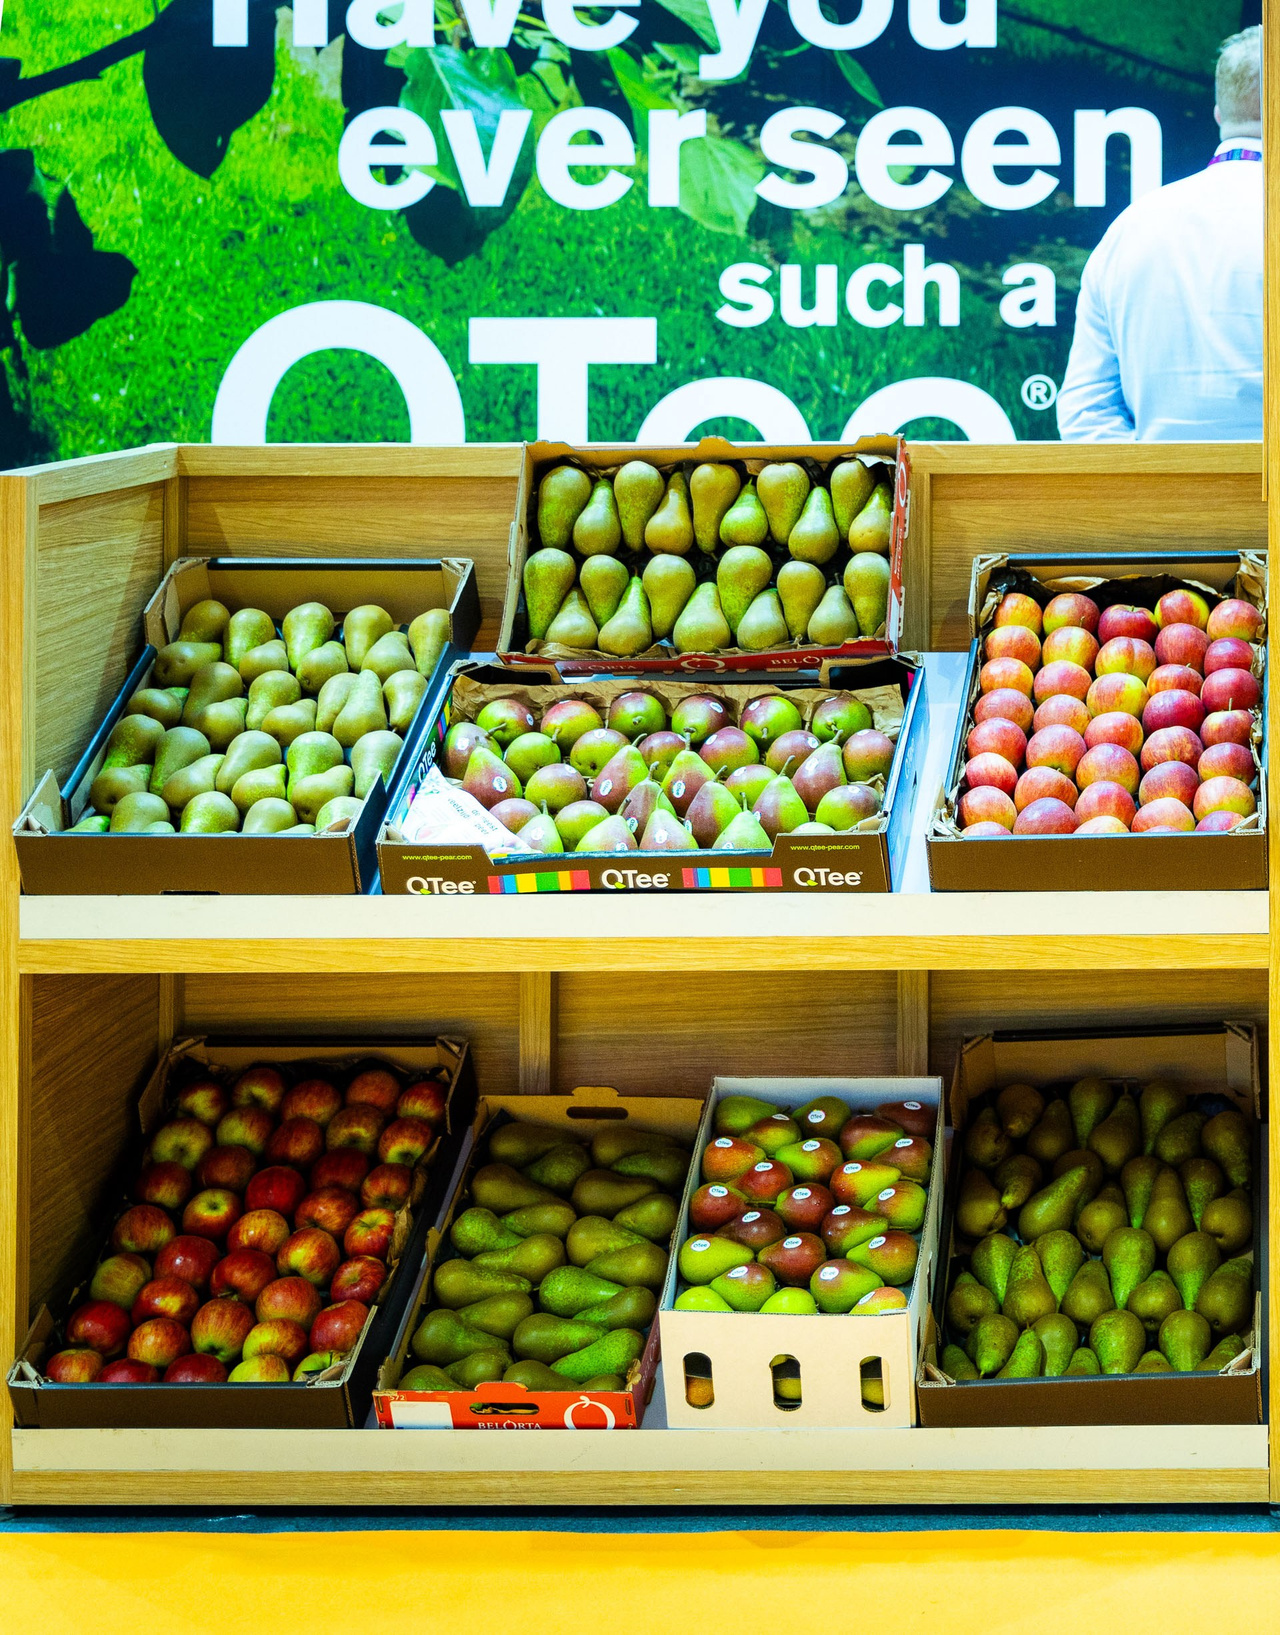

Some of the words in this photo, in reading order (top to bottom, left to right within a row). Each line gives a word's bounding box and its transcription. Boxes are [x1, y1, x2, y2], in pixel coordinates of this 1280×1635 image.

[338, 106, 708, 210] ever
[753, 106, 1163, 211] seen
[716, 244, 960, 328] such
[1000, 262, 1056, 328] a
[402, 854, 473, 863] www.qtee-pear.com
[790, 844, 860, 853] www.qtee-pear.com
[406, 876, 475, 895] QTee
[601, 868, 670, 889] QTee
[793, 867, 862, 887] QTee
